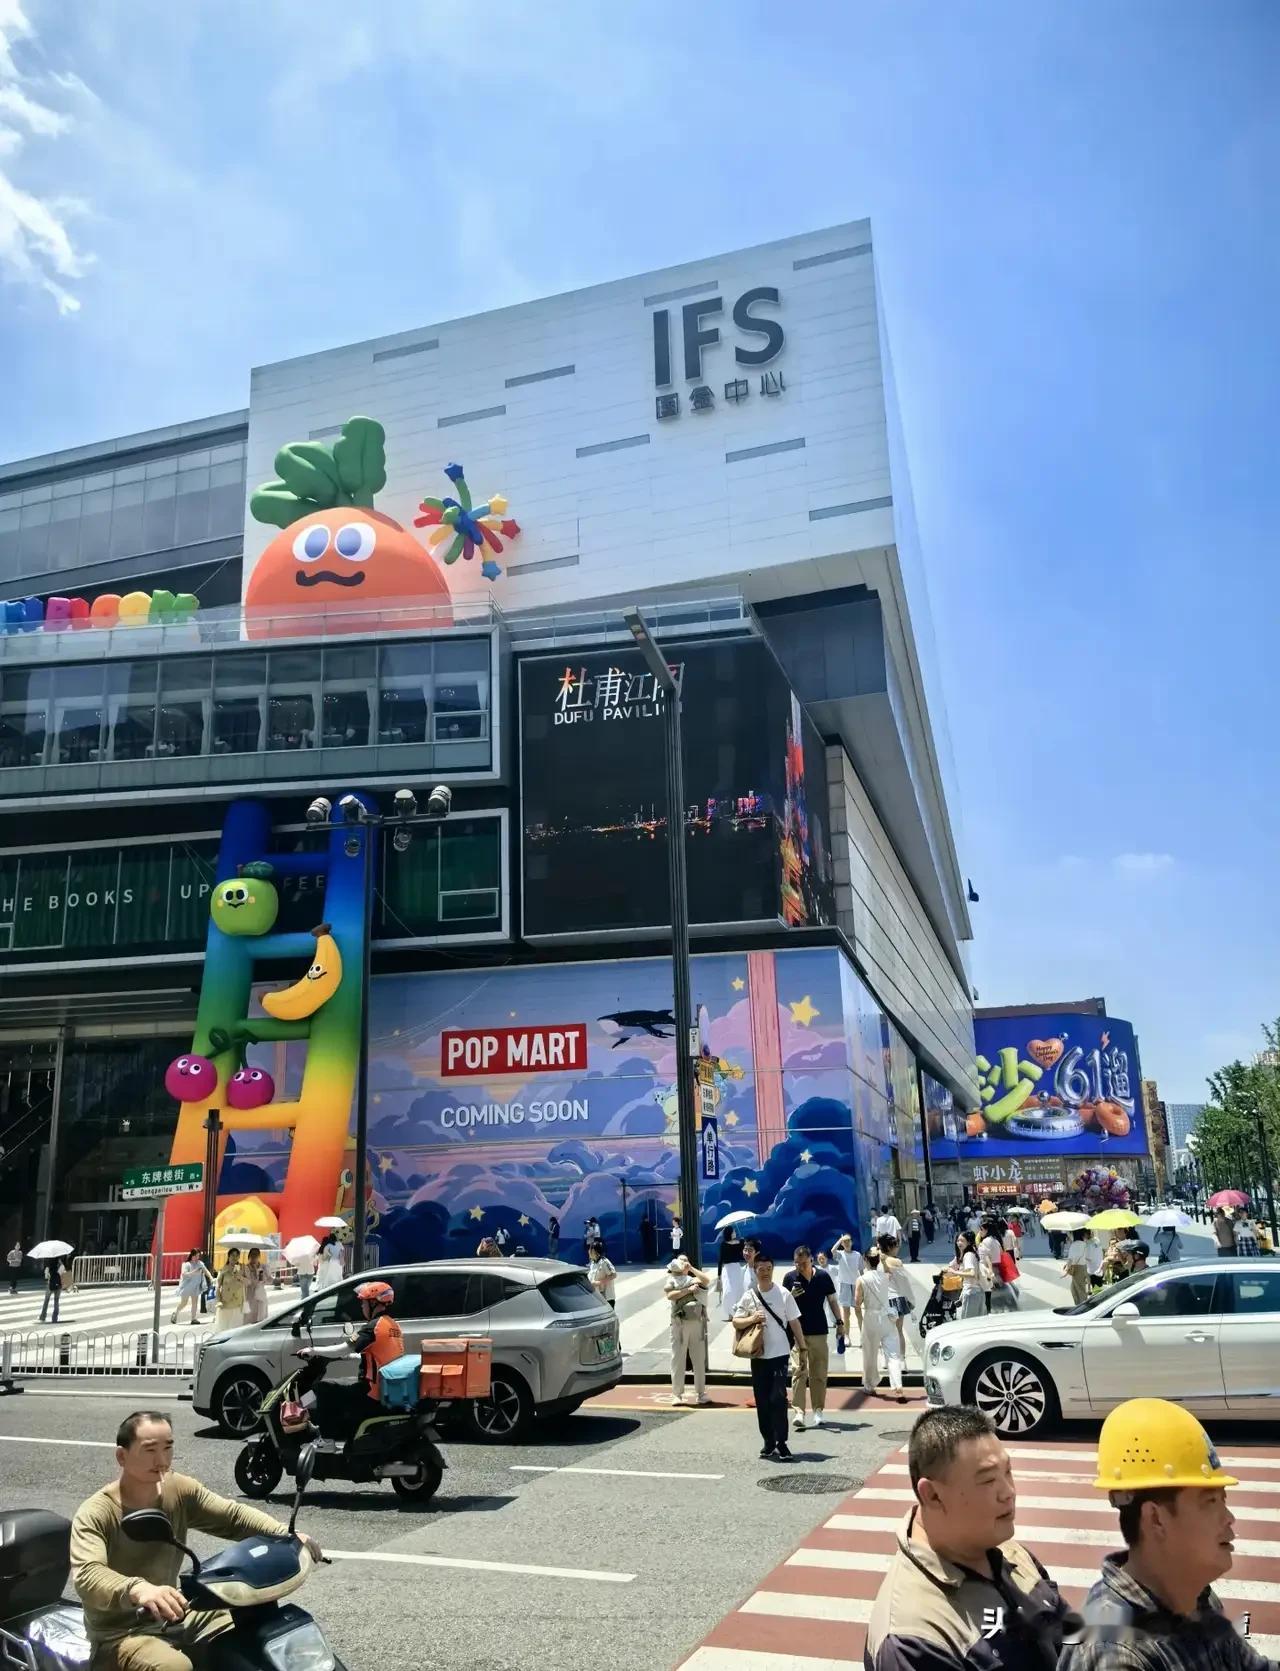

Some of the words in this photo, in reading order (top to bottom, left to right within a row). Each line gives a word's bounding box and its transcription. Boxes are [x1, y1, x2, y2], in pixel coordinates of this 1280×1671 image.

[653, 286, 784, 387] IFS
[655, 371, 786, 420] 国金中心
[554, 709, 594, 725] DUFU
[603, 701, 682, 720] PAVILI
[49, 889, 134, 910] BOOKS
[448, 1036, 499, 1070] POP
[507, 1031, 579, 1067] MART
[440, 1103, 525, 1128] COMING
[528, 1099, 589, 1123] SOON
[142, 1169, 184, 1184] 东牌楼街
